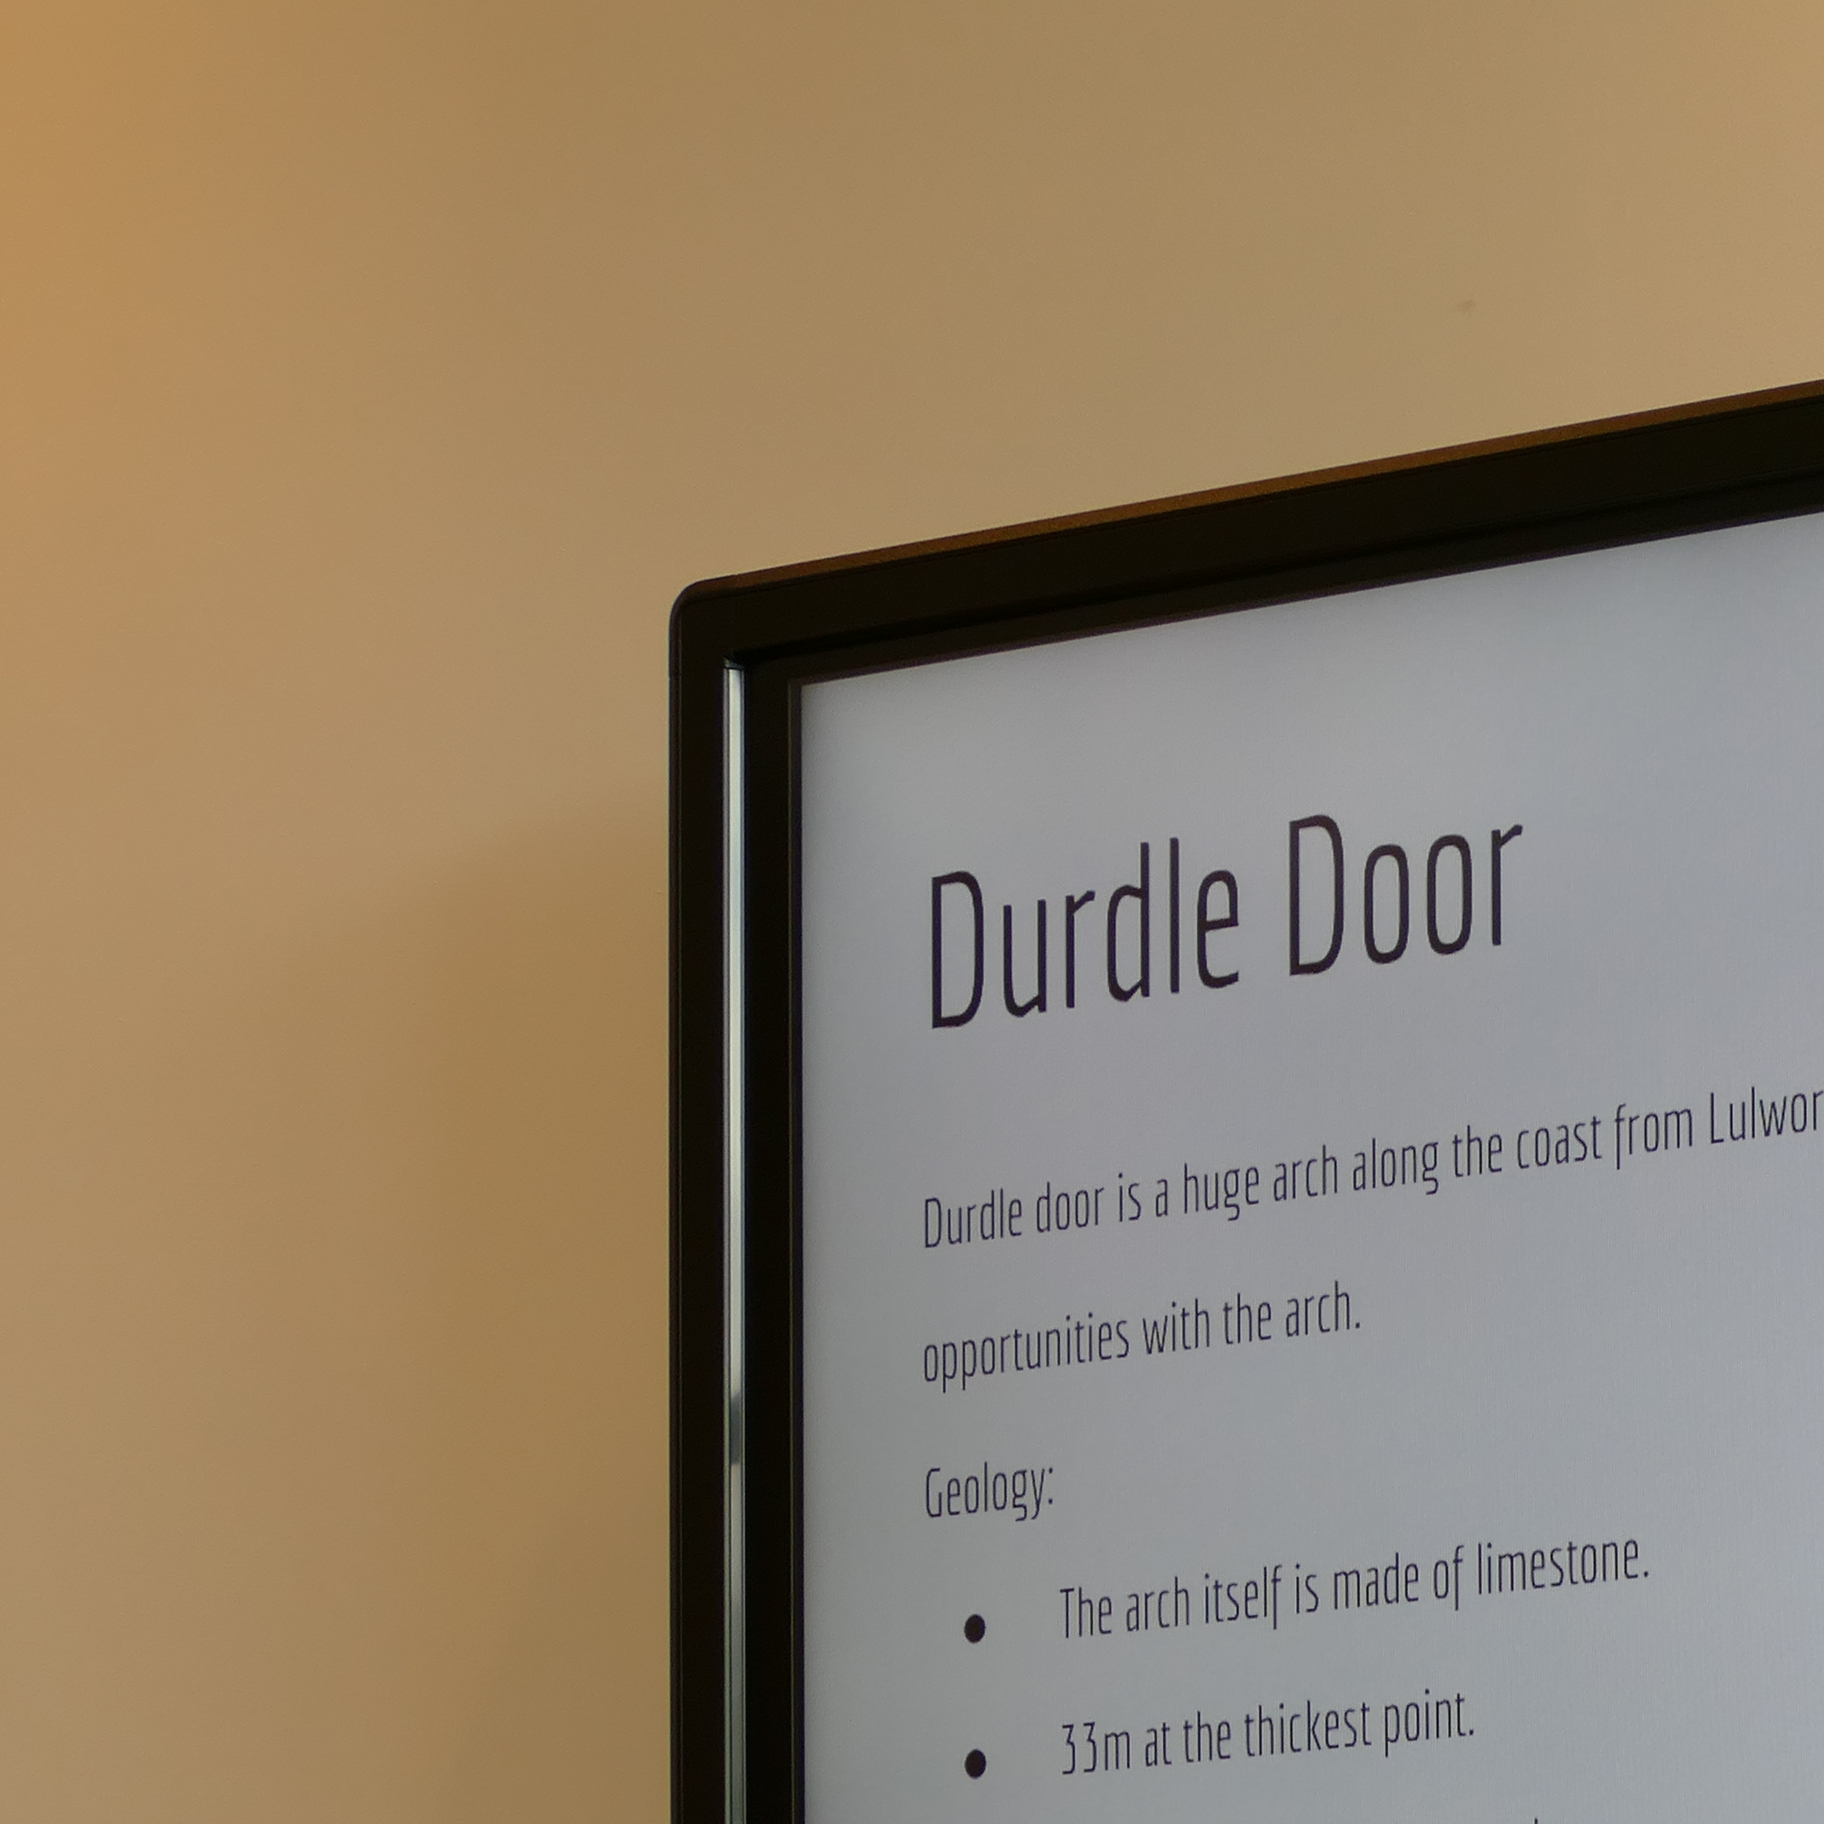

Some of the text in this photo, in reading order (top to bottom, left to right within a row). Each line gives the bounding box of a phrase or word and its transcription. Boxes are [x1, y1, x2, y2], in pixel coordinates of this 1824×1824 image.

[931, 813, 1524, 1030] Durdle Door
[924, 1187, 1023, 1249] Durdle
[1036, 1180, 1105, 1234] door
[1117, 1171, 1142, 1223] is
[1155, 1178, 1169, 1218] a
[1183, 1162, 1260, 1222] huge
[1272, 1143, 1338, 1202] arch
[1352, 1137, 1440, 1196] along
[1451, 1124, 1503, 1179] the
[1516, 1115, 1603, 1170] coast
[1614, 1102, 1694, 1171] from
[923, 1279, 1361, 1395] opportunities with the arch.
[925, 1460, 1054, 1523] Geology:
[1058, 1538, 1650, 1640] The arch itself is made of limestone.
[1061, 1687, 1475, 1776] 33m at the thickest point.
